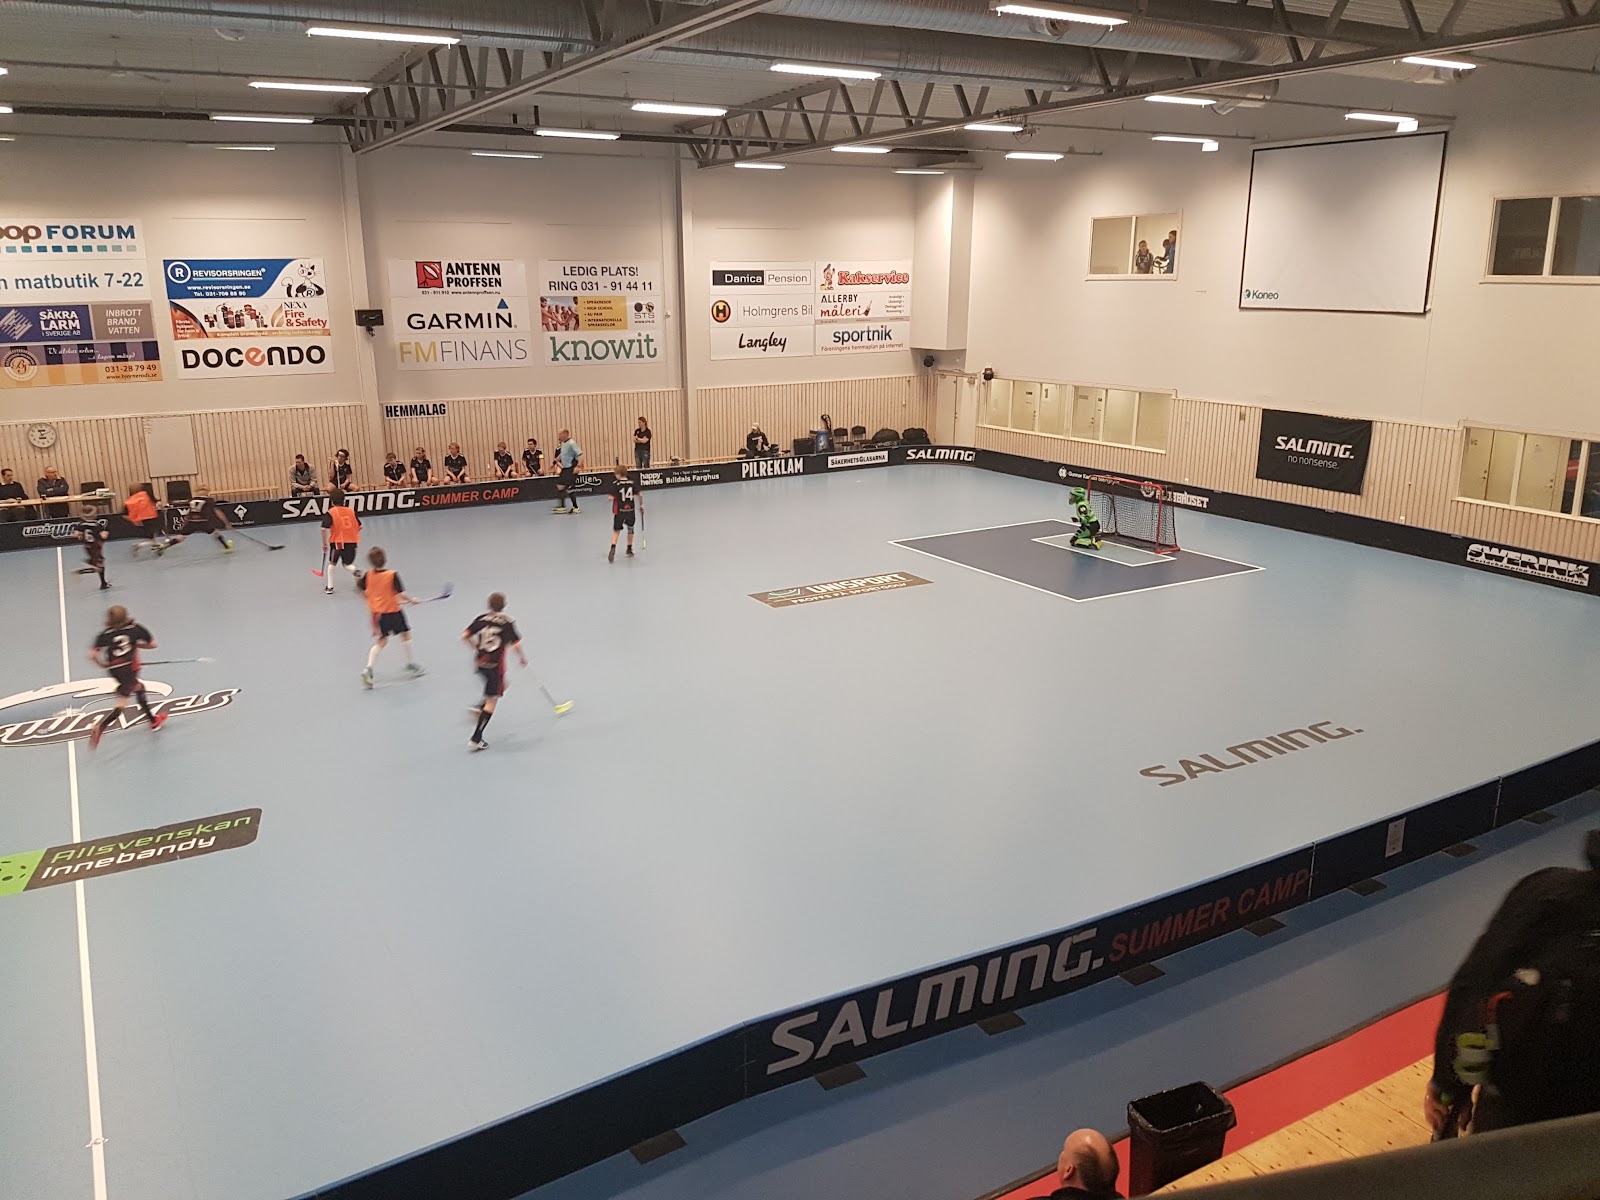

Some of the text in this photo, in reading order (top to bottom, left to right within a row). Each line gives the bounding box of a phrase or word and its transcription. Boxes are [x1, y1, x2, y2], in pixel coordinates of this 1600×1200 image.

[0, 225, 136, 243] op FORUM
[192, 269, 263, 277] REVISORSRINGEN
[445, 262, 501, 276] ANTENN
[563, 266, 639, 276] LEDIG PLATS!
[15, 273, 99, 290] matbutik
[104, 272, 144, 288] 7-22
[446, 277, 502, 288] PROFFSEN
[725, 273, 808, 283] Danica Pension
[837, 270, 910, 286] Kakservice
[548, 281, 578, 291] RING
[581, 281, 599, 291] 031
[610, 281, 622, 291] 91
[626, 281, 639, 291] 44
[641, 281, 653, 291] 11
[821, 294, 858, 303] ALLERBY
[1252, 290, 1279, 300] Koneo
[39, 309, 78, 320] SÄKRA
[106, 309, 143, 317] INBROTT
[285, 310, 305, 318] Fire
[743, 304, 814, 320] Holmgrens Bil
[820, 304, 861, 317] måleri
[40, 319, 81, 331] LARM
[107, 318, 137, 326] BRAND
[286, 318, 327, 328] & Safety
[407, 312, 513, 330] GARMIN
[108, 327, 140, 335] VATTEN
[833, 325, 892, 345] sportnik
[550, 332, 657, 361] knowit
[739, 331, 787, 352] Langley
[135, 364, 145, 372] 79
[385, 403, 446, 418] HEMMALAG
[1287, 455, 1298, 464] no
[741, 457, 804, 479] PILREKLAM
[640, 472, 661, 480] happy
[421, 491, 480, 506] SUMMER
[482, 487, 520, 501] CAMP
[619, 487, 633, 502] 14
[1467, 544, 1590, 582] SWERINK
[805, 573, 907, 594] UNISPORT
[791, 593, 832, 604] PROFFS
[112, 633, 133, 657] 3
[50, 816, 252, 864] Allsvenskan
[41, 836, 217, 879] Innebandy
[1110, 898, 1231, 963] SUMMER
[1236, 868, 1311, 916] CAMP
